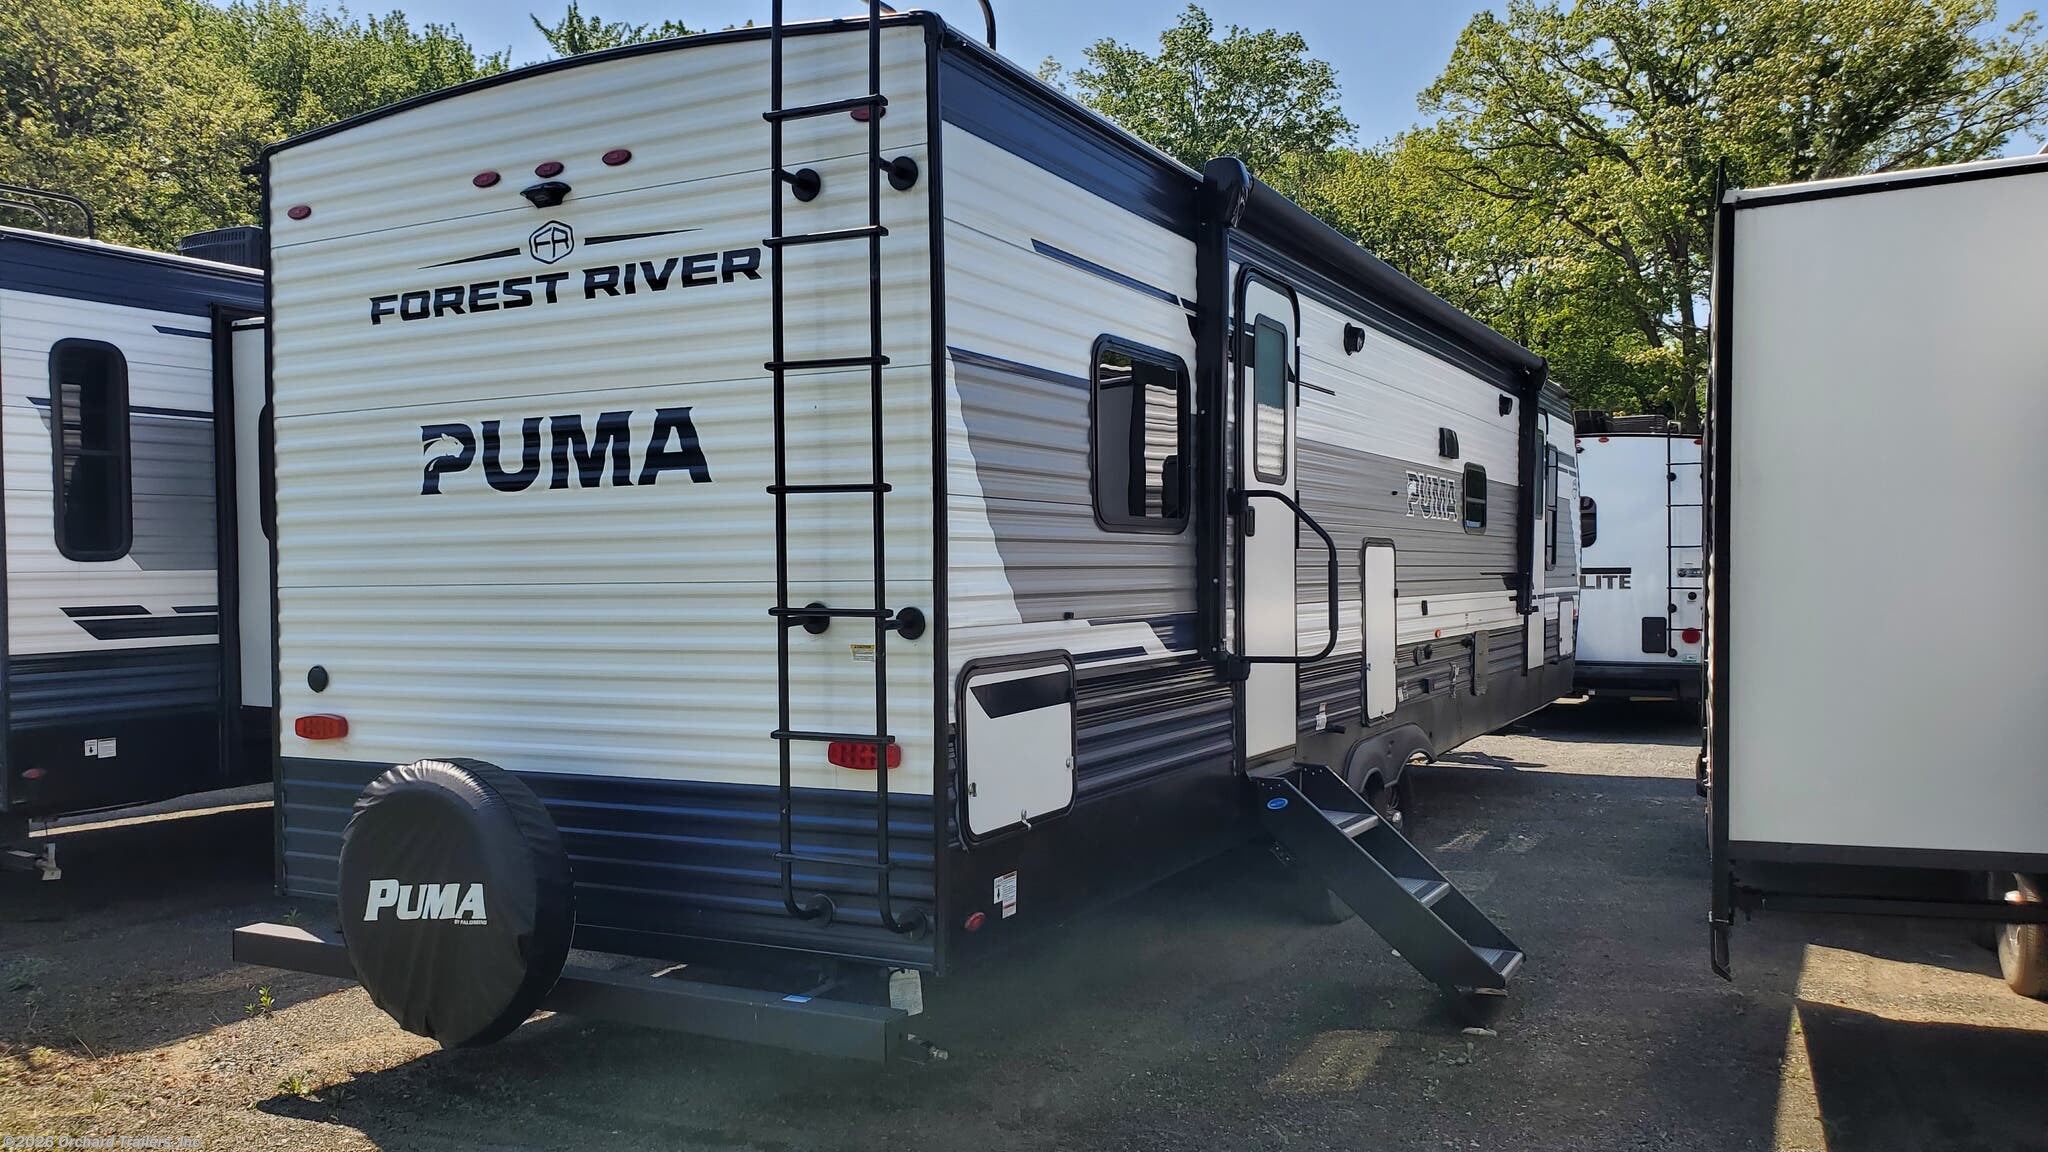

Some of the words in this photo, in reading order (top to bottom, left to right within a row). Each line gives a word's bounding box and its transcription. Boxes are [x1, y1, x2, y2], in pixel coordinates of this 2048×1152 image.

[370, 272, 569, 325] FOREST
[582, 247, 762, 299] RIVER
[420, 406, 712, 495] PUMA
[1405, 469, 1458, 522] PUMA
[1580, 575, 1631, 589] LITE
[363, 879, 487, 921] PUMA
